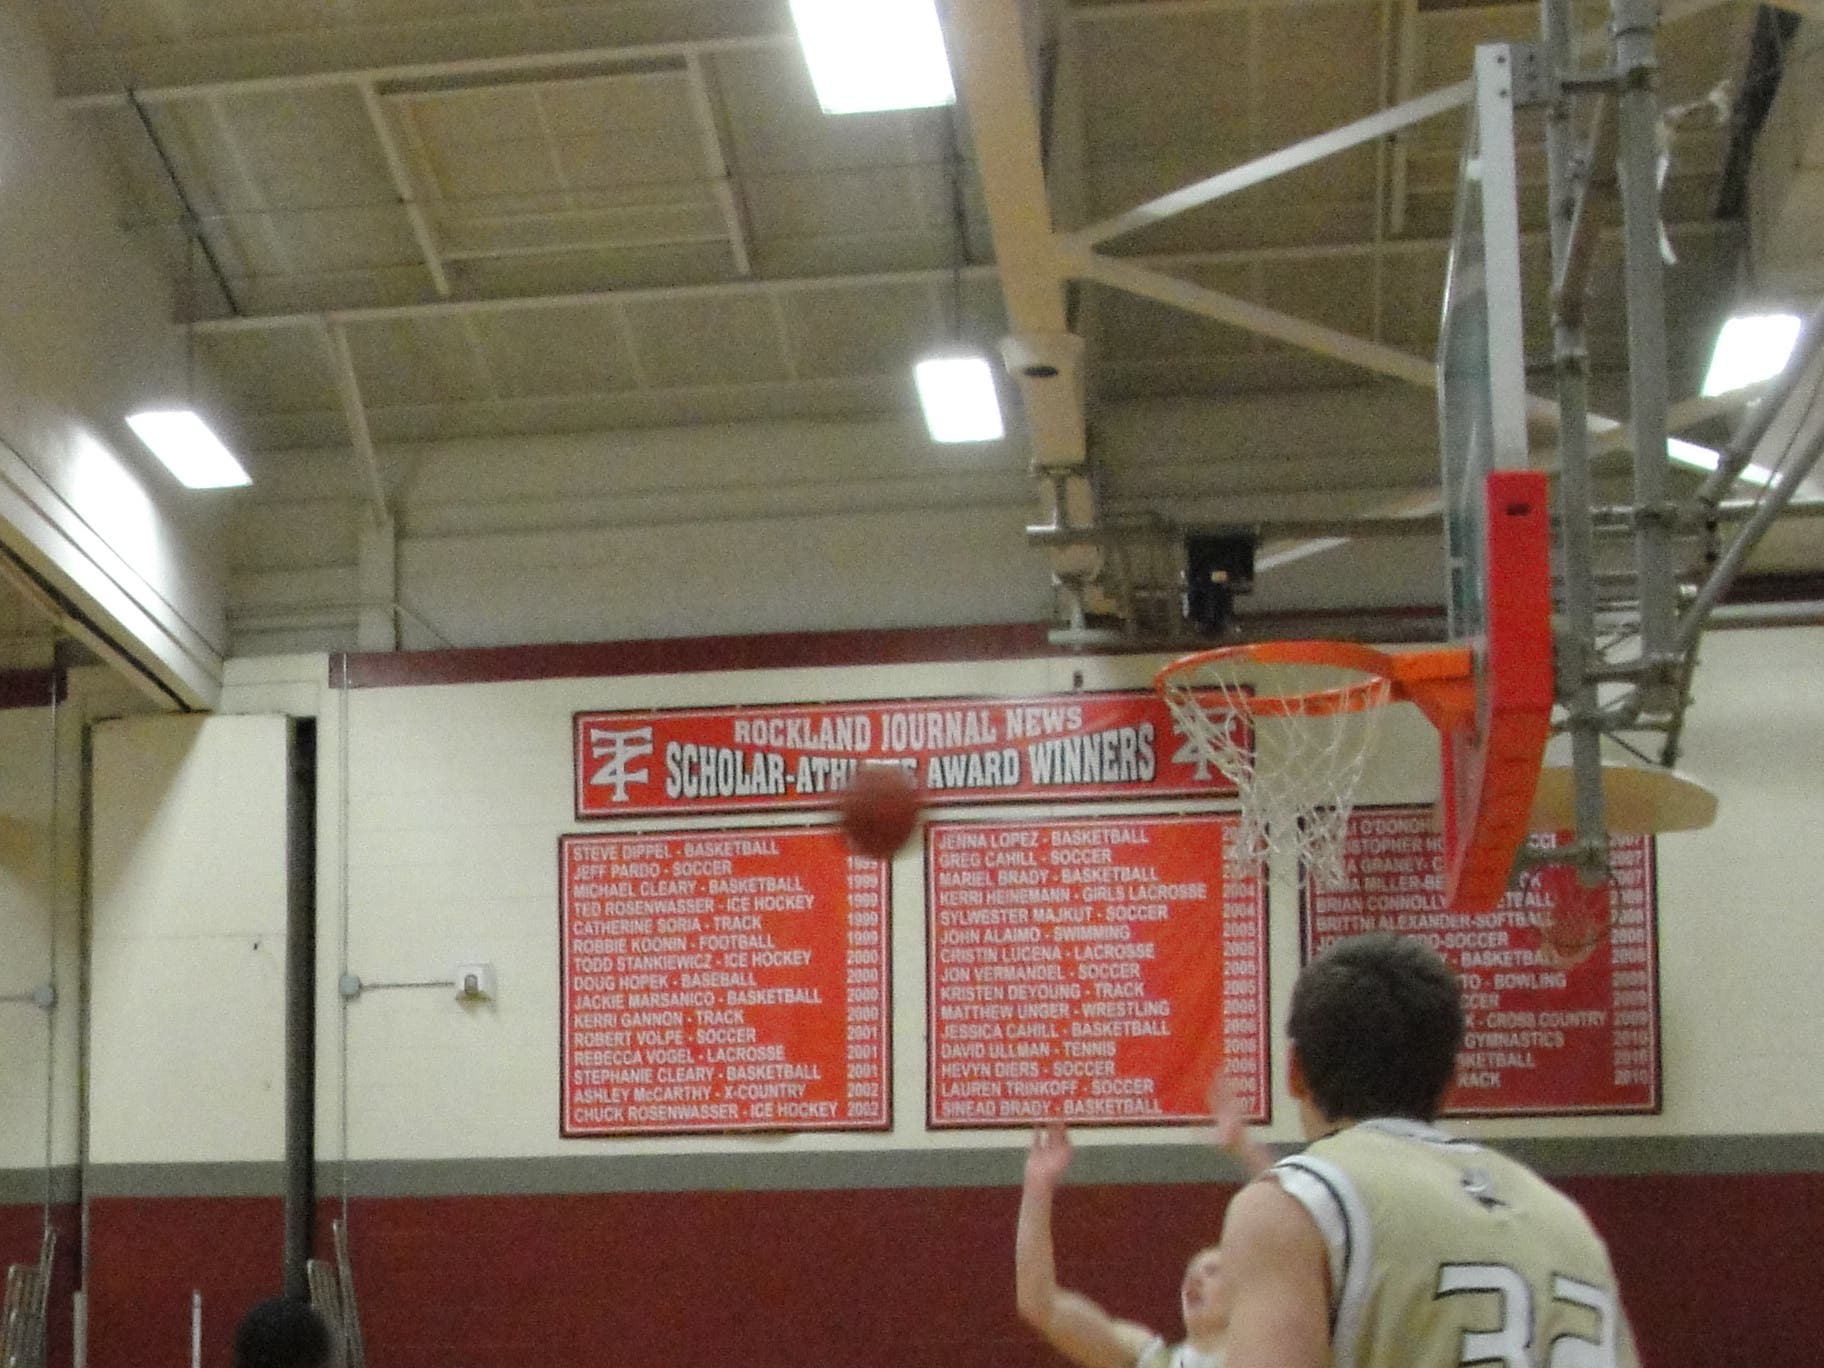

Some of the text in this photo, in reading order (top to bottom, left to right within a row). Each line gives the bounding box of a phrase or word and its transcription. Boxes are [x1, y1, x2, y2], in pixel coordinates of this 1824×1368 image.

[733, 705, 1083, 752] ROCKLAND JOURNAL NEWS
[926, 748, 1020, 790] AWARD
[1030, 723, 1157, 787] WINNERS
[991, 831, 1039, 849] LOPEZ
[1052, 828, 1149, 847] BASKETBALL
[685, 841, 781, 859] BASKETBALL
[941, 849, 1113, 869] GREG CAHILL SOCCER
[575, 865, 607, 881] JEFF
[673, 861, 733, 878] SOCCER
[999, 870, 1049, 887] BRADY
[1063, 867, 1159, 885] BASKETBALL
[575, 877, 805, 900] MICHAEL CLEARY BASKETBALL
[1083, 887, 1125, 904] GIRLS
[1129, 885, 1208, 903] LACROSSE
[575, 896, 815, 918] TED ROSENWASSER ICE HOCKEY
[1107, 905, 1169, 923] SOCCER
[575, 916, 763, 937] CATHERINE SORIA TRACK
[941, 929, 981, 946] JOHN
[1055, 925, 1131, 943] SWIMMING
[575, 939, 627, 955] ROBBIE
[700, 935, 775, 952] FOOTBALL
[1075, 944, 1157, 962] LACROSSE
[575, 957, 614, 974] TODD
[617, 955, 713, 973] STANKIEWICZ
[725, 954, 749, 970] ICE
[753, 952, 813, 969] HOCKEY
[575, 976, 615, 993] DOUG
[681, 972, 757, 990] BASEBALL
[941, 967, 971, 984] JON
[1079, 964, 1142, 981] SOCCER
[1493, 973, 1567, 990] BOWLING
[575, 994, 625, 1011] JACKIE
[727, 990, 823, 1007] BASKETBALL
[941, 986, 1005, 1003] KRISTEN
[1095, 983, 1145, 1000] TRACK
[575, 1013, 619, 1030] KERRI
[622, 1012, 683, 1029] GANNON
[697, 1010, 745, 1027] TRACK
[941, 1005, 1015, 1022] MATTHEW
[1083, 1002, 1171, 1019] WRESTLING
[575, 1031, 634, 1048] ROBERT
[637, 1030, 685, 1047] VOLPE
[697, 1029, 757, 1045] SOCCER
[941, 1021, 1172, 1041] JESSICA CAHILL BASKETBALL
[1464, 1031, 1565, 1049] GYMNASTICS
[575, 1050, 643, 1067] REBECCA
[647, 1049, 695, 1065] VOGEL
[707, 1047, 787, 1064] LACROSSE
[943, 1043, 987, 1060] DAVID
[1063, 1041, 1117, 1058] TENNIS
[575, 1068, 653, 1085] STEPHANIE
[658, 1067, 715, 1084] CLEARY
[727, 1065, 823, 1082] BASKETBALL
[1054, 1060, 1117, 1077] SOCCER
[577, 1087, 631, 1104] ASHLEY
[943, 1081, 1002, 1098] LAUREN
[1093, 1079, 1155, 1096] SOCCER
[577, 1106, 625, 1122] CHUCK
[629, 1104, 739, 1121] ROSENWASSER
[751, 1103, 773, 1119] ICE
[778, 1102, 839, 1119] HOCKEY
[1065, 1098, 1164, 1116] BASKETBALL
